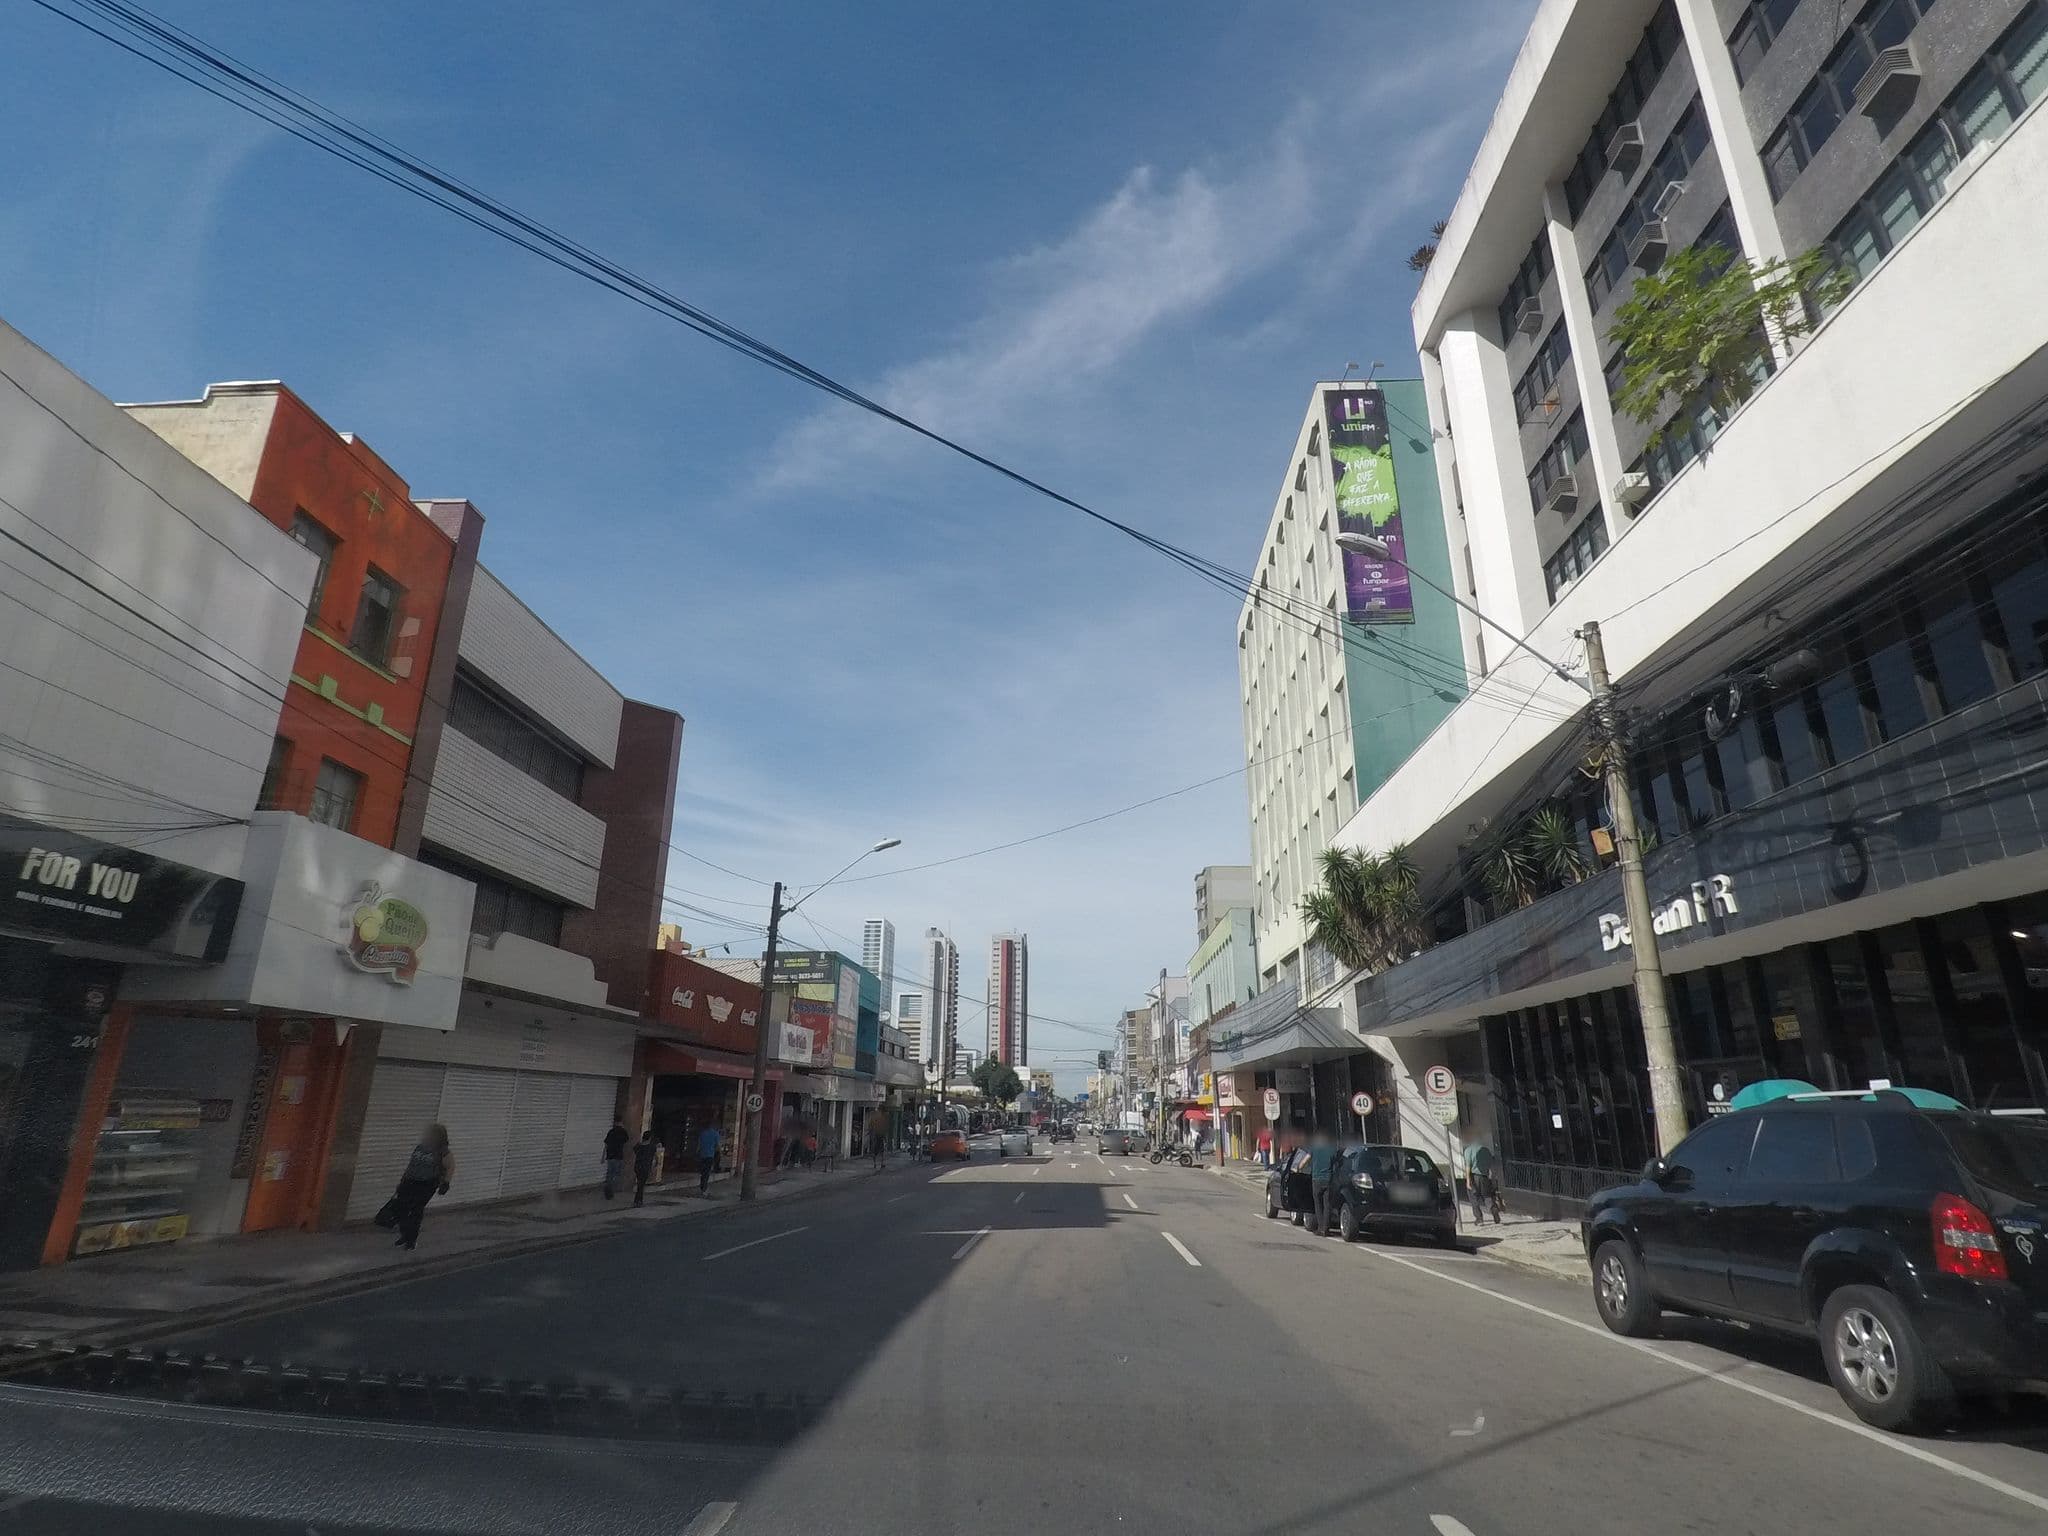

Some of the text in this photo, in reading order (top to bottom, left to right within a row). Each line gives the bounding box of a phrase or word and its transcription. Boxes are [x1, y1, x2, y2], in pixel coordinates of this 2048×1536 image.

[1343, 461, 1353, 473] A
[1356, 469, 1375, 484] QUE
[1373, 479, 1381, 491] A
[20, 847, 141, 903] FOR YOU
[71, 1035, 97, 1049] 241
[1433, 1072, 1446, 1089] E
[748, 1096, 762, 1107] 40
[1355, 1097, 1369, 1108] 40
